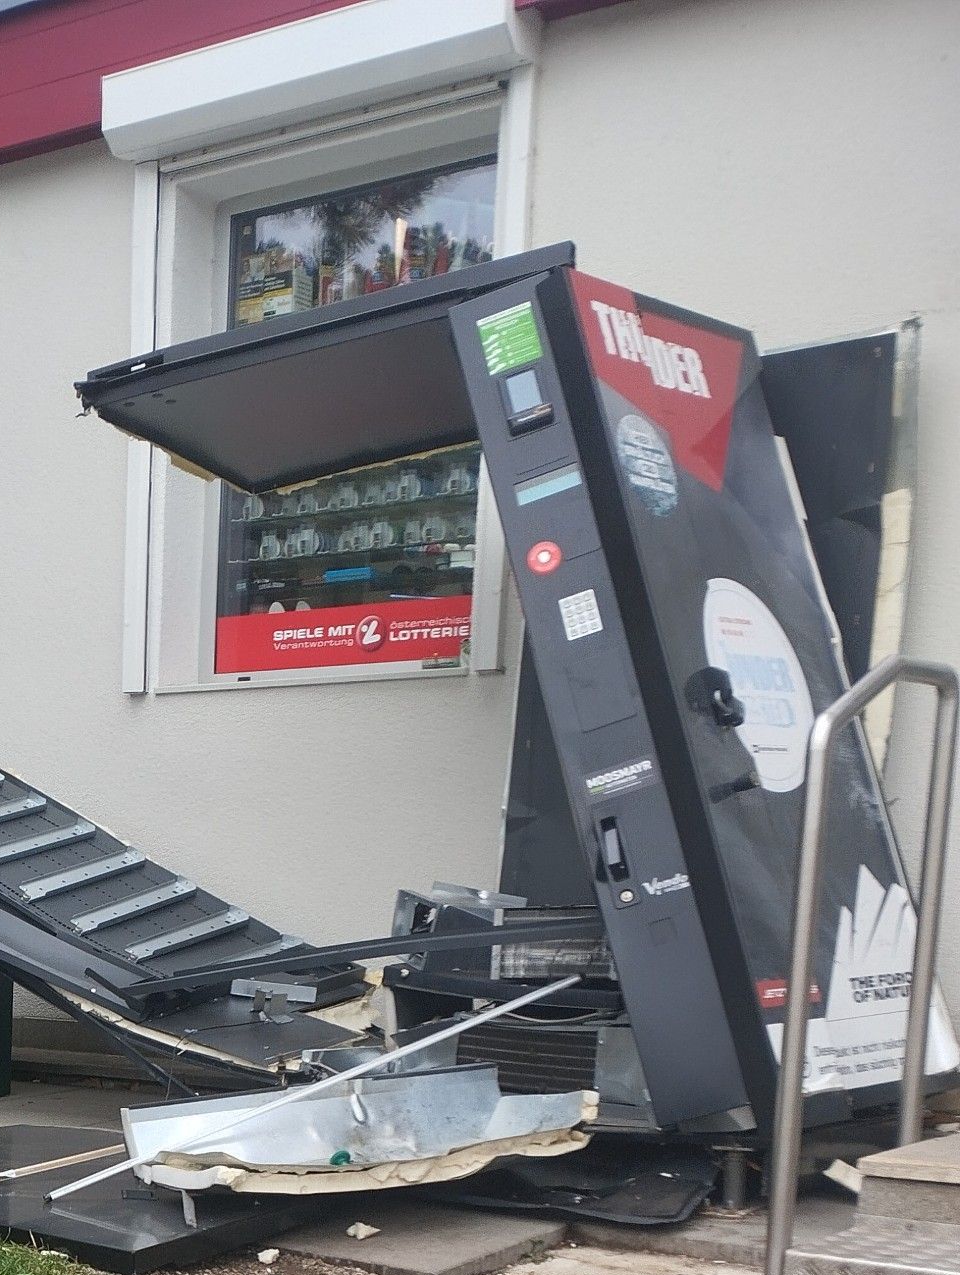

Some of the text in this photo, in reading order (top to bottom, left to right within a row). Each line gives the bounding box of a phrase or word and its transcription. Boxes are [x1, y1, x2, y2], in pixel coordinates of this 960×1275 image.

[390, 616, 471, 630] österreichisc
[273, 624, 356, 642] SPIELE MIT
[389, 625, 470, 642] LOTTERIE
[273, 637, 354, 651] Verantwortung
[877, 971, 912, 986] FORC
[873, 985, 910, 1000] NATU
